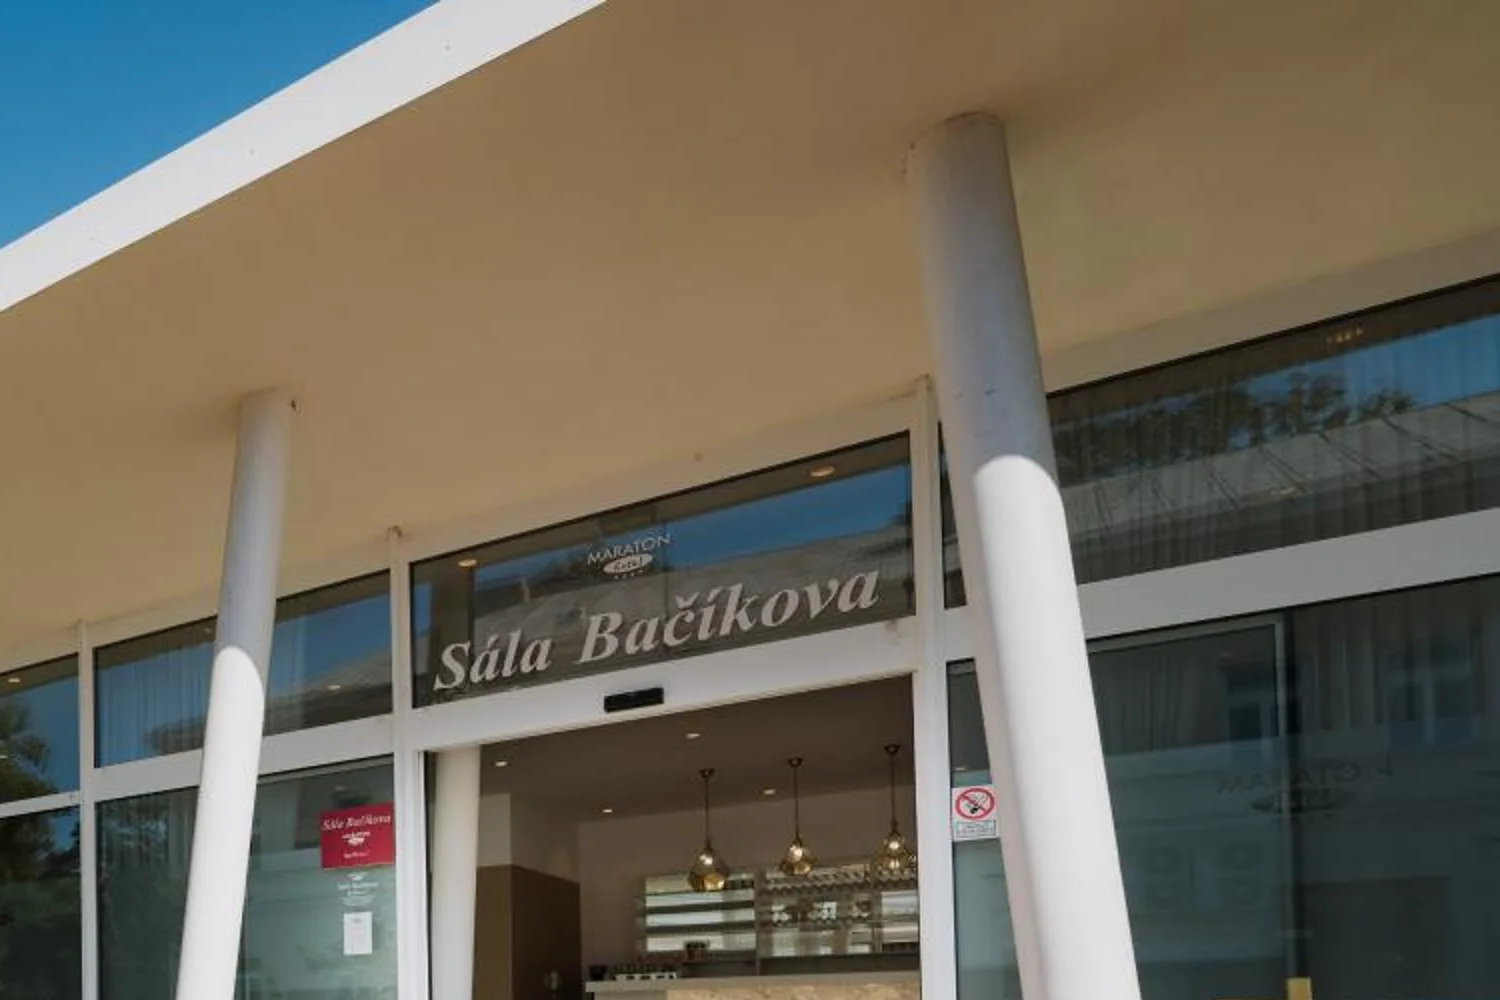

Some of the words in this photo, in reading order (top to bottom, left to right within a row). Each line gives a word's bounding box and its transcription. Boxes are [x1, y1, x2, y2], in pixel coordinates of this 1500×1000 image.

[588, 532, 671, 565] MARATON
[433, 628, 552, 692] Sála
[576, 570, 880, 664] Bačíkova
